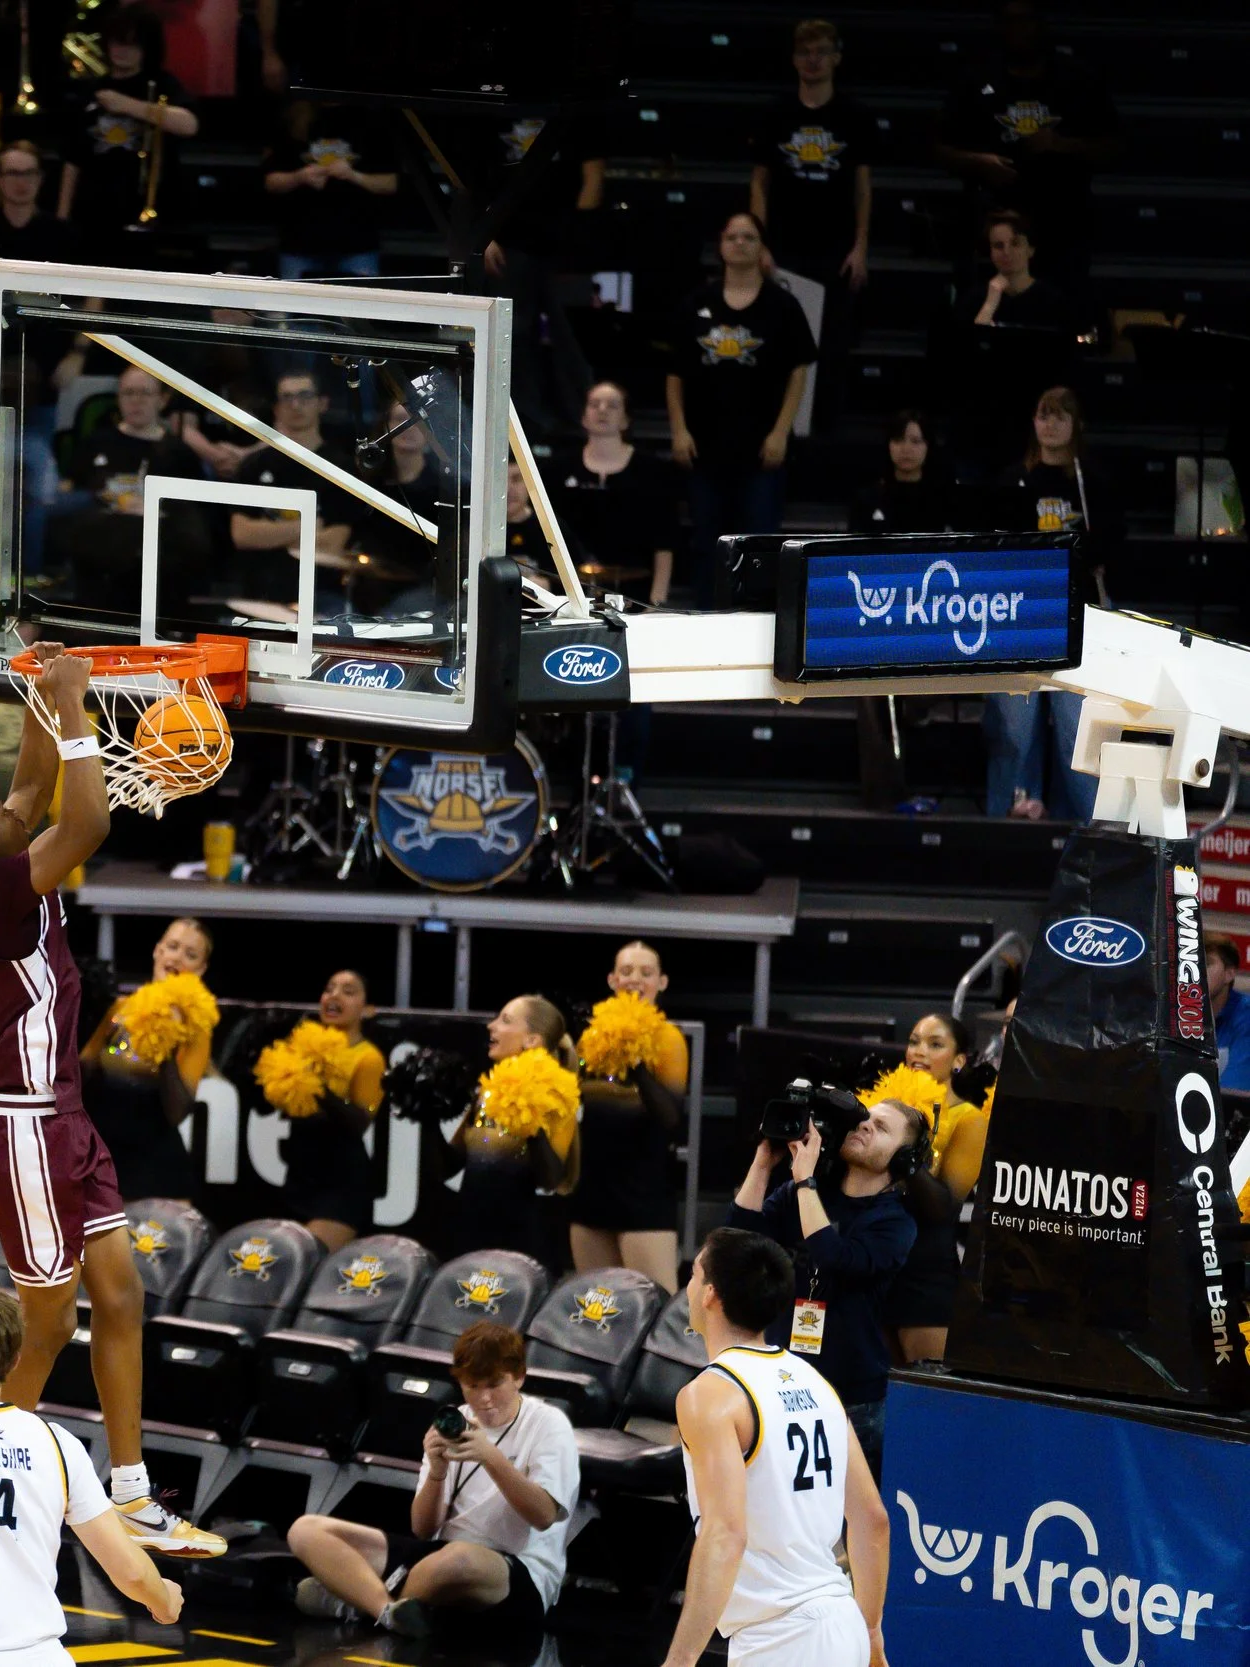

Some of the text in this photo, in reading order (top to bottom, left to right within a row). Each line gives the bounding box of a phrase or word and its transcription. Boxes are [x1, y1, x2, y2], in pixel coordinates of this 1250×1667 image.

[340, 663, 389, 689] Ford
[558, 650, 607, 678] Ford
[414, 771, 502, 803] NORSE
[1064, 922, 1128, 960] Ford
[992, 1161, 1146, 1220] DONATOS PIZZA
[991, 1211, 1145, 1246] Every piece is important.
[1206, 1284, 1234, 1366] Bank
[787, 1419, 832, 1491] 24
